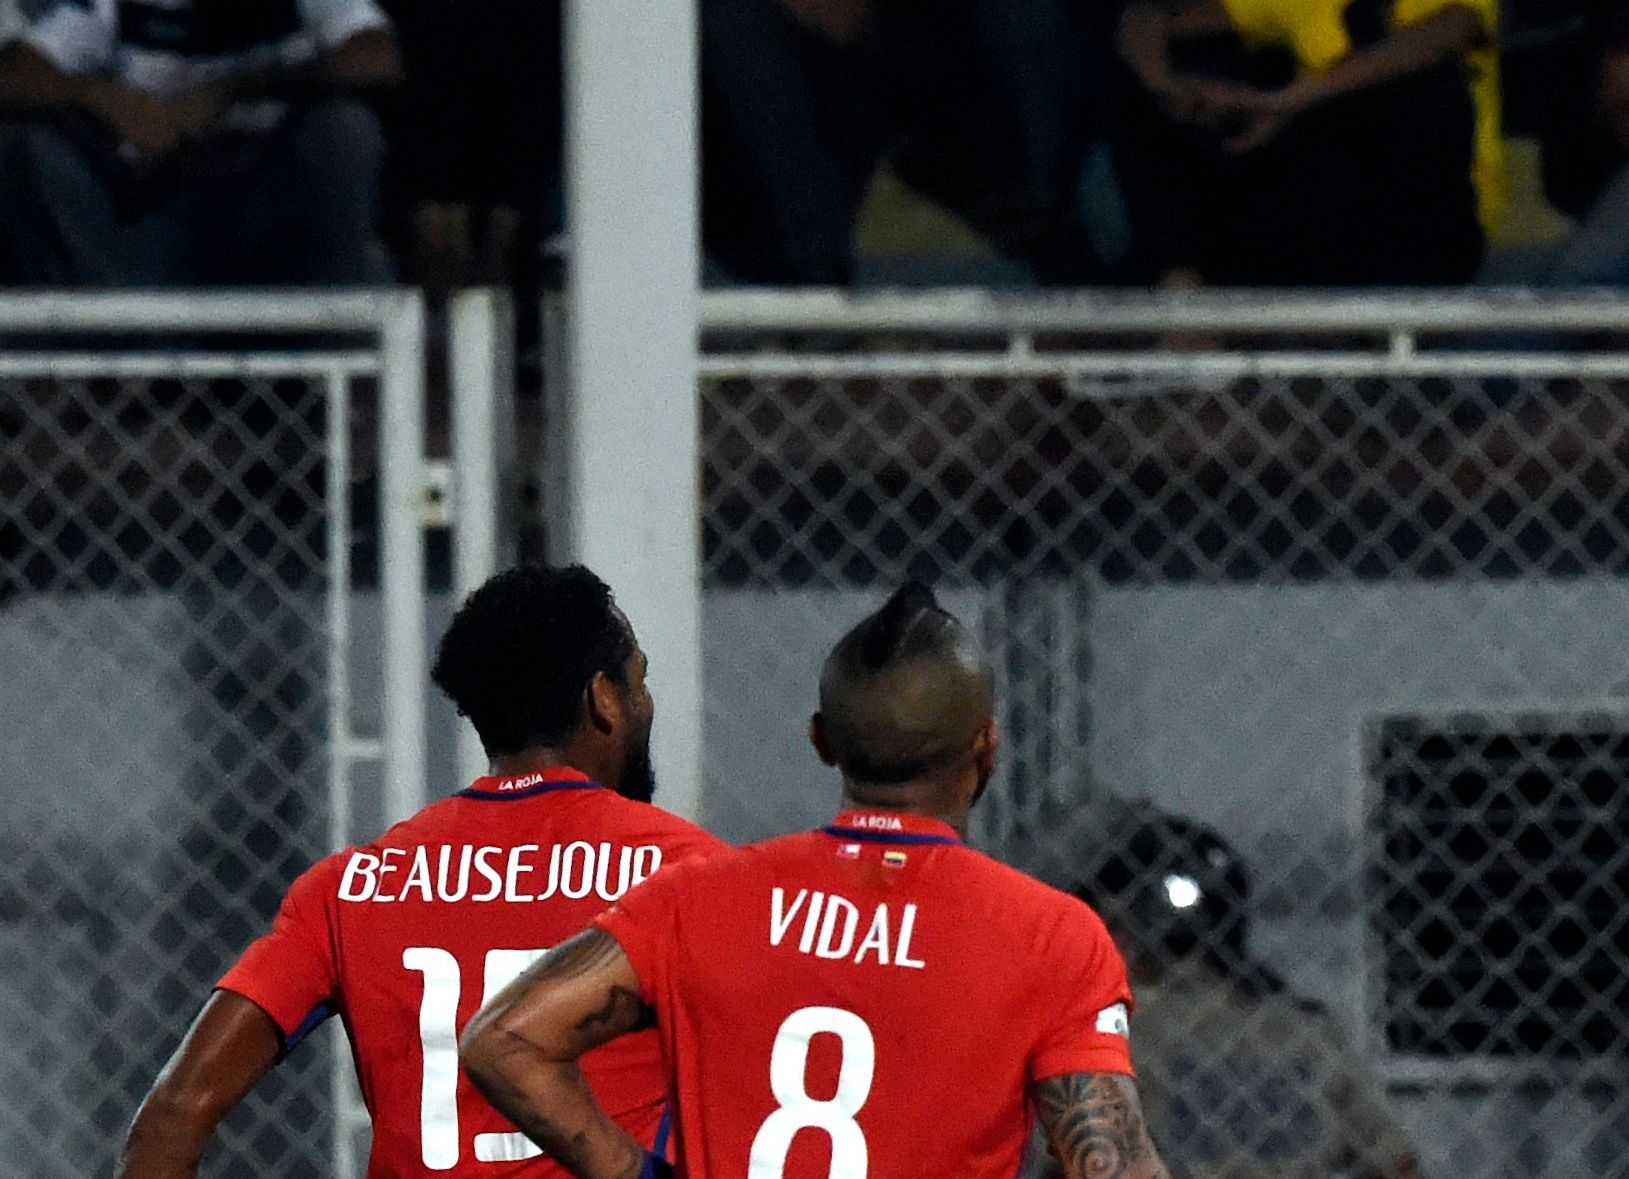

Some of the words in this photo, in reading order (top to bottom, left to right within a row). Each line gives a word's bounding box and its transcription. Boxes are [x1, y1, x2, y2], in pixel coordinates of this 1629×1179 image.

[498, 780, 514, 791] LA
[515, 773, 544, 790] ROJA
[852, 816, 867, 827] LA
[769, 886, 926, 969] VIDAL
